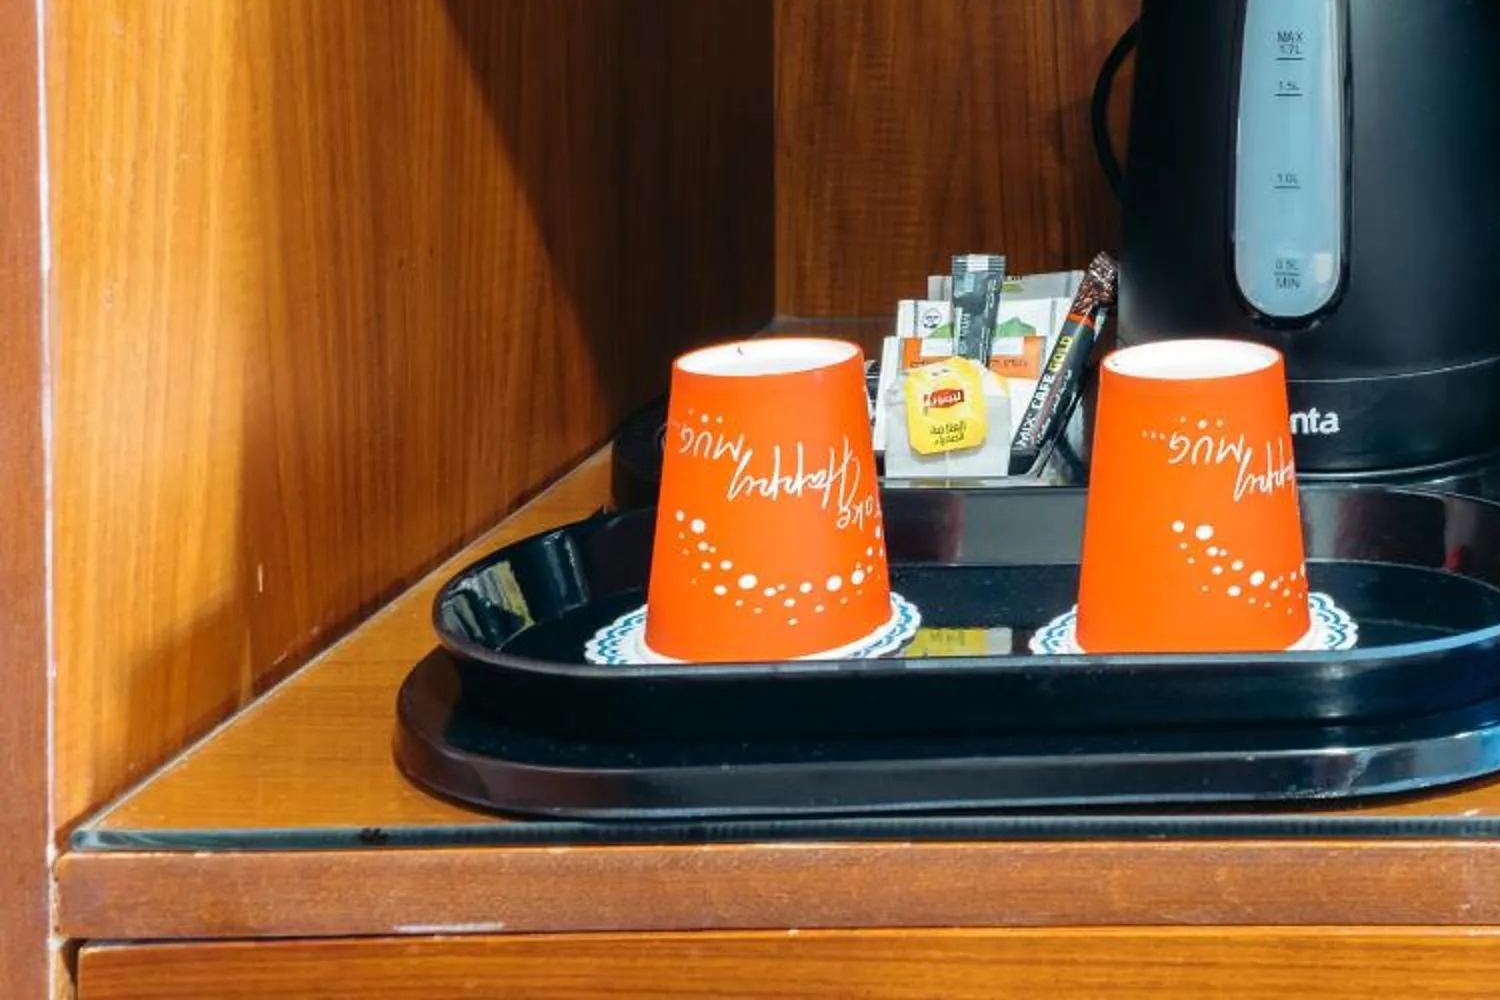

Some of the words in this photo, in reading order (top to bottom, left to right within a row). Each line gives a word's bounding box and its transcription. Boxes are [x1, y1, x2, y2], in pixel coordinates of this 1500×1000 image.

[1277, 30, 1303, 42] MAX
[1275, 277, 1301, 290] MIN
[1031, 374, 1055, 410] CAFE
[1048, 335, 1073, 373] GOLD
[726, 435, 861, 511] Happy
